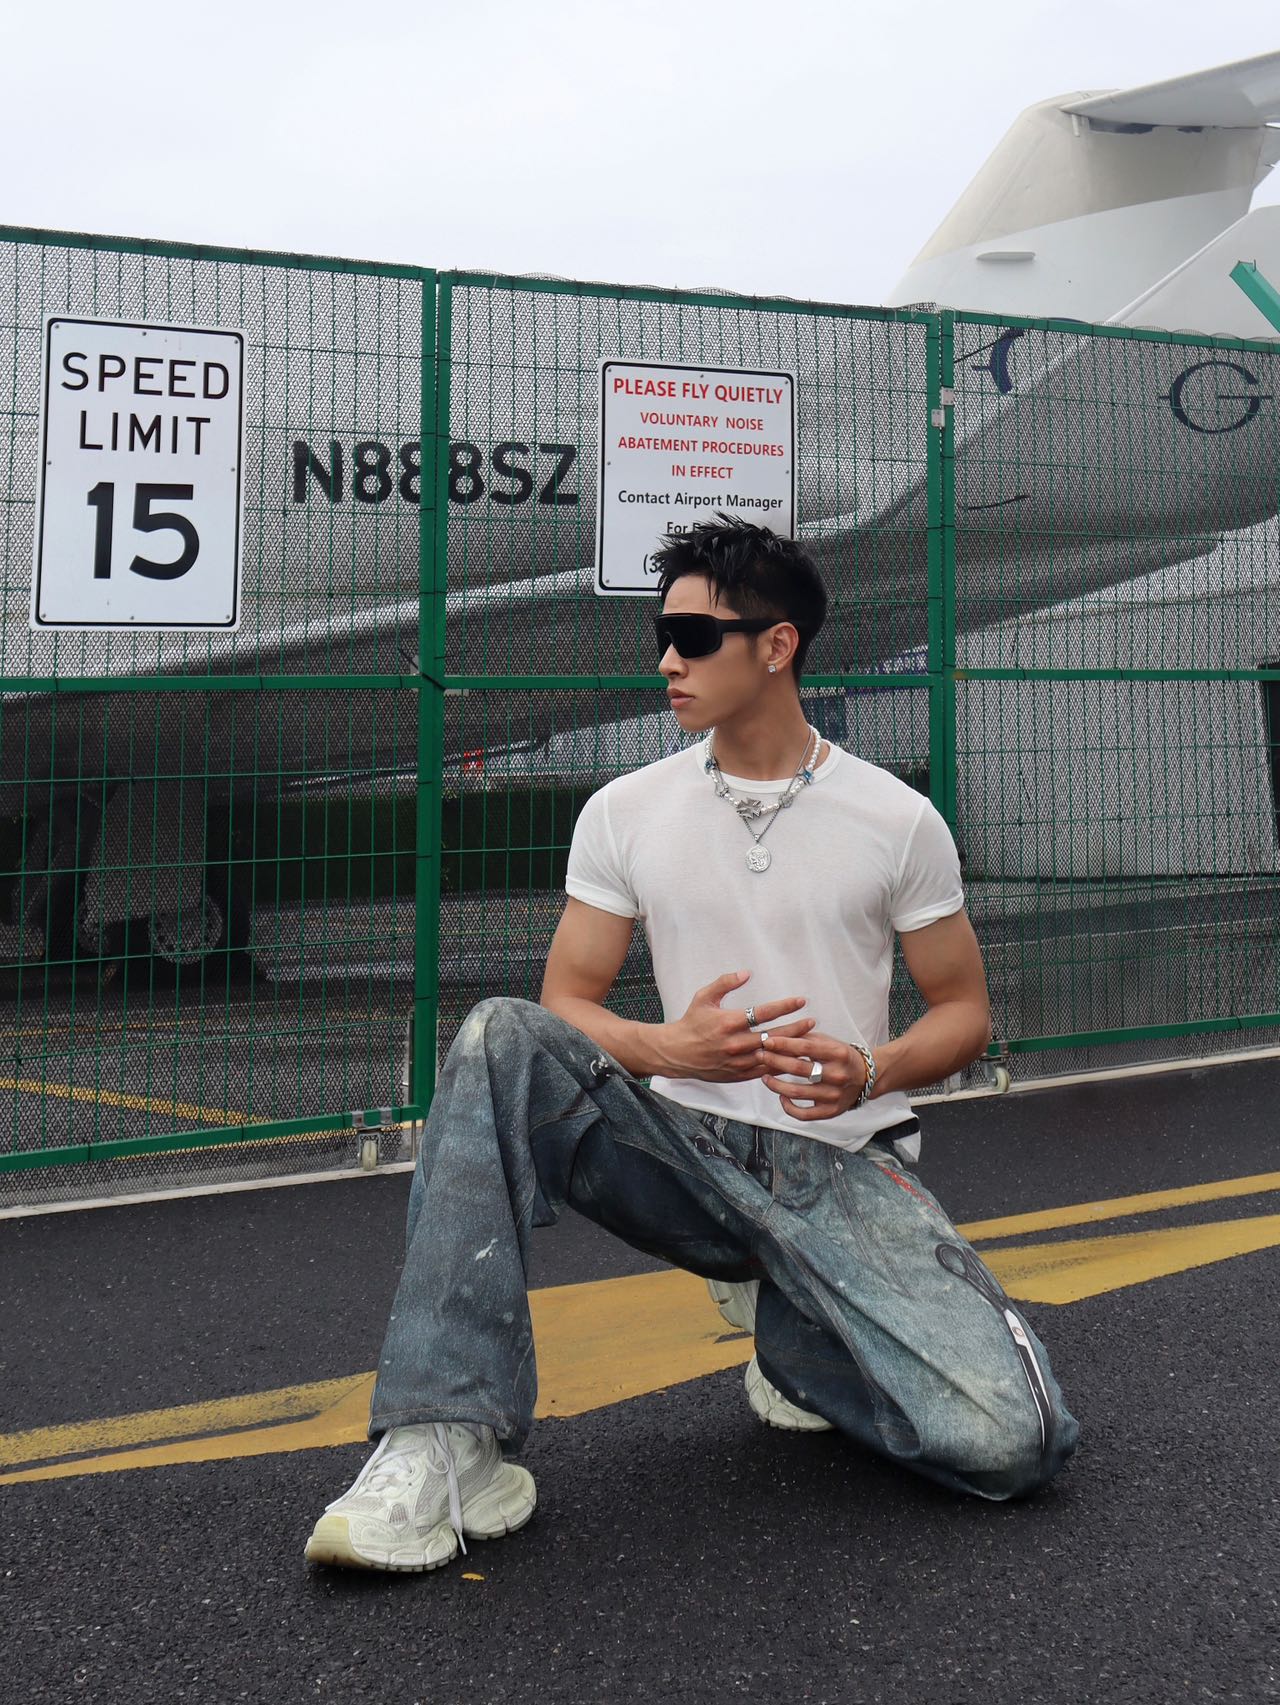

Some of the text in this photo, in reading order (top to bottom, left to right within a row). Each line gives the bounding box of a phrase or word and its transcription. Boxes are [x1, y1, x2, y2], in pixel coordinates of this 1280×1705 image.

[61, 352, 229, 399] SPEED
[613, 378, 783, 404] PLEASE FLY QUIETLY
[640, 412, 764, 430] VOLUNTARY NOISE
[79, 410, 211, 455] LIMIT
[618, 437, 784, 456] ABATEMENT PROCEDURES
[672, 465, 733, 479] IN EFFECT
[618, 490, 783, 511] Contact Airport Manager
[87, 482, 200, 581] 15
[667, 521, 688, 534] For
